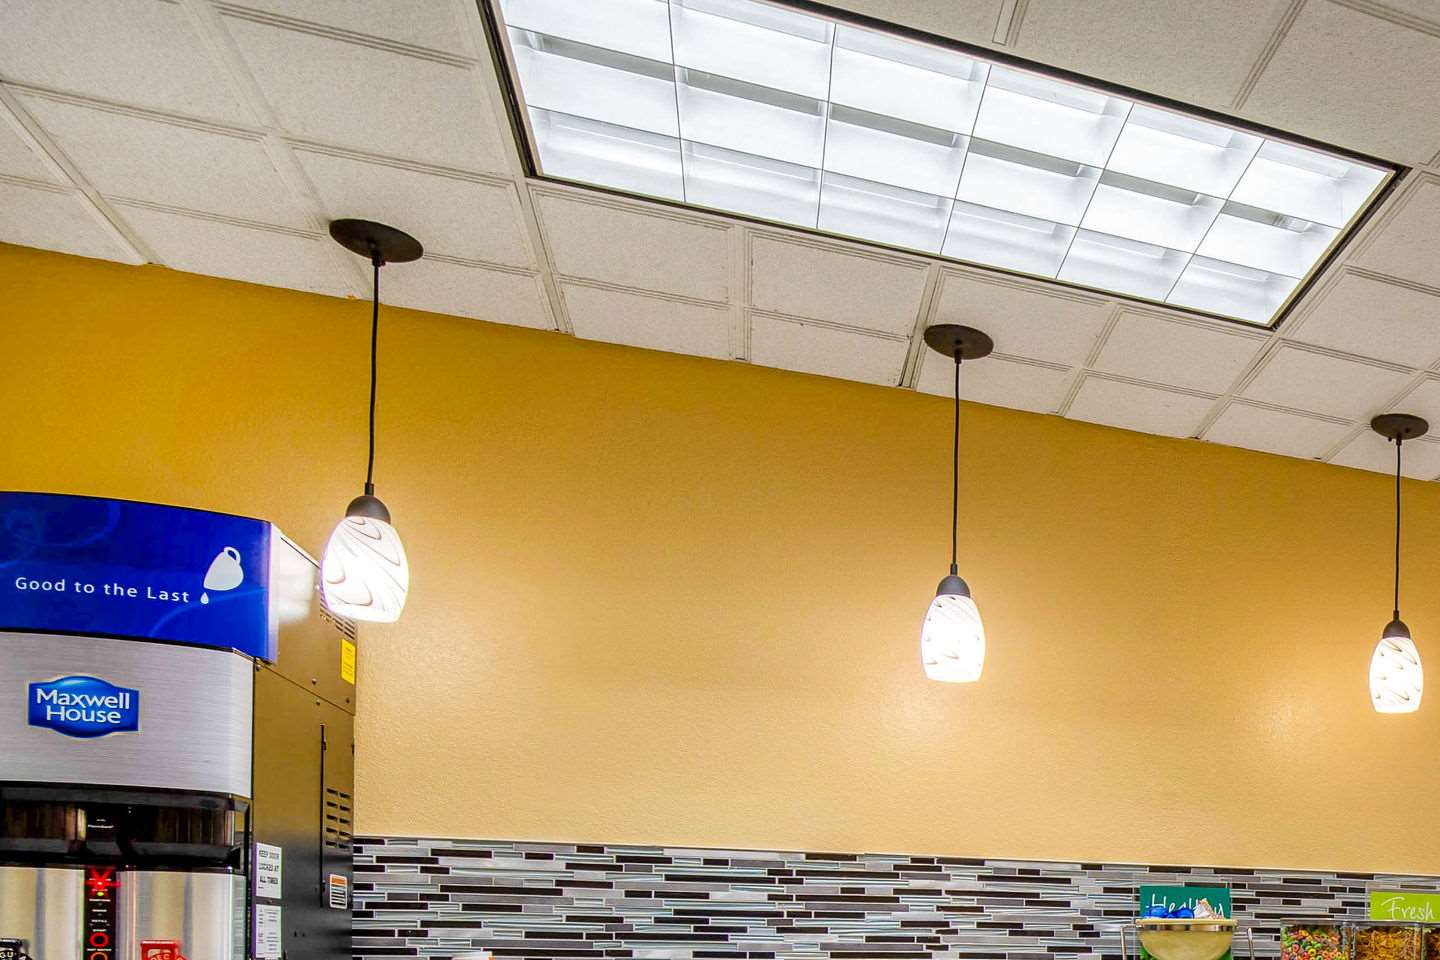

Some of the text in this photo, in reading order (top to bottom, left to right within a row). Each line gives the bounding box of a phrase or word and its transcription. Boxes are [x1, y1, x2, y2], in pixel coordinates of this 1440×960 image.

[15, 577, 190, 603] Good to the Last
[36, 688, 130, 710] Maxwell
[46, 705, 121, 724] House
[1146, 893, 1224, 918] Hely
[1381, 896, 1435, 920] Fresh
